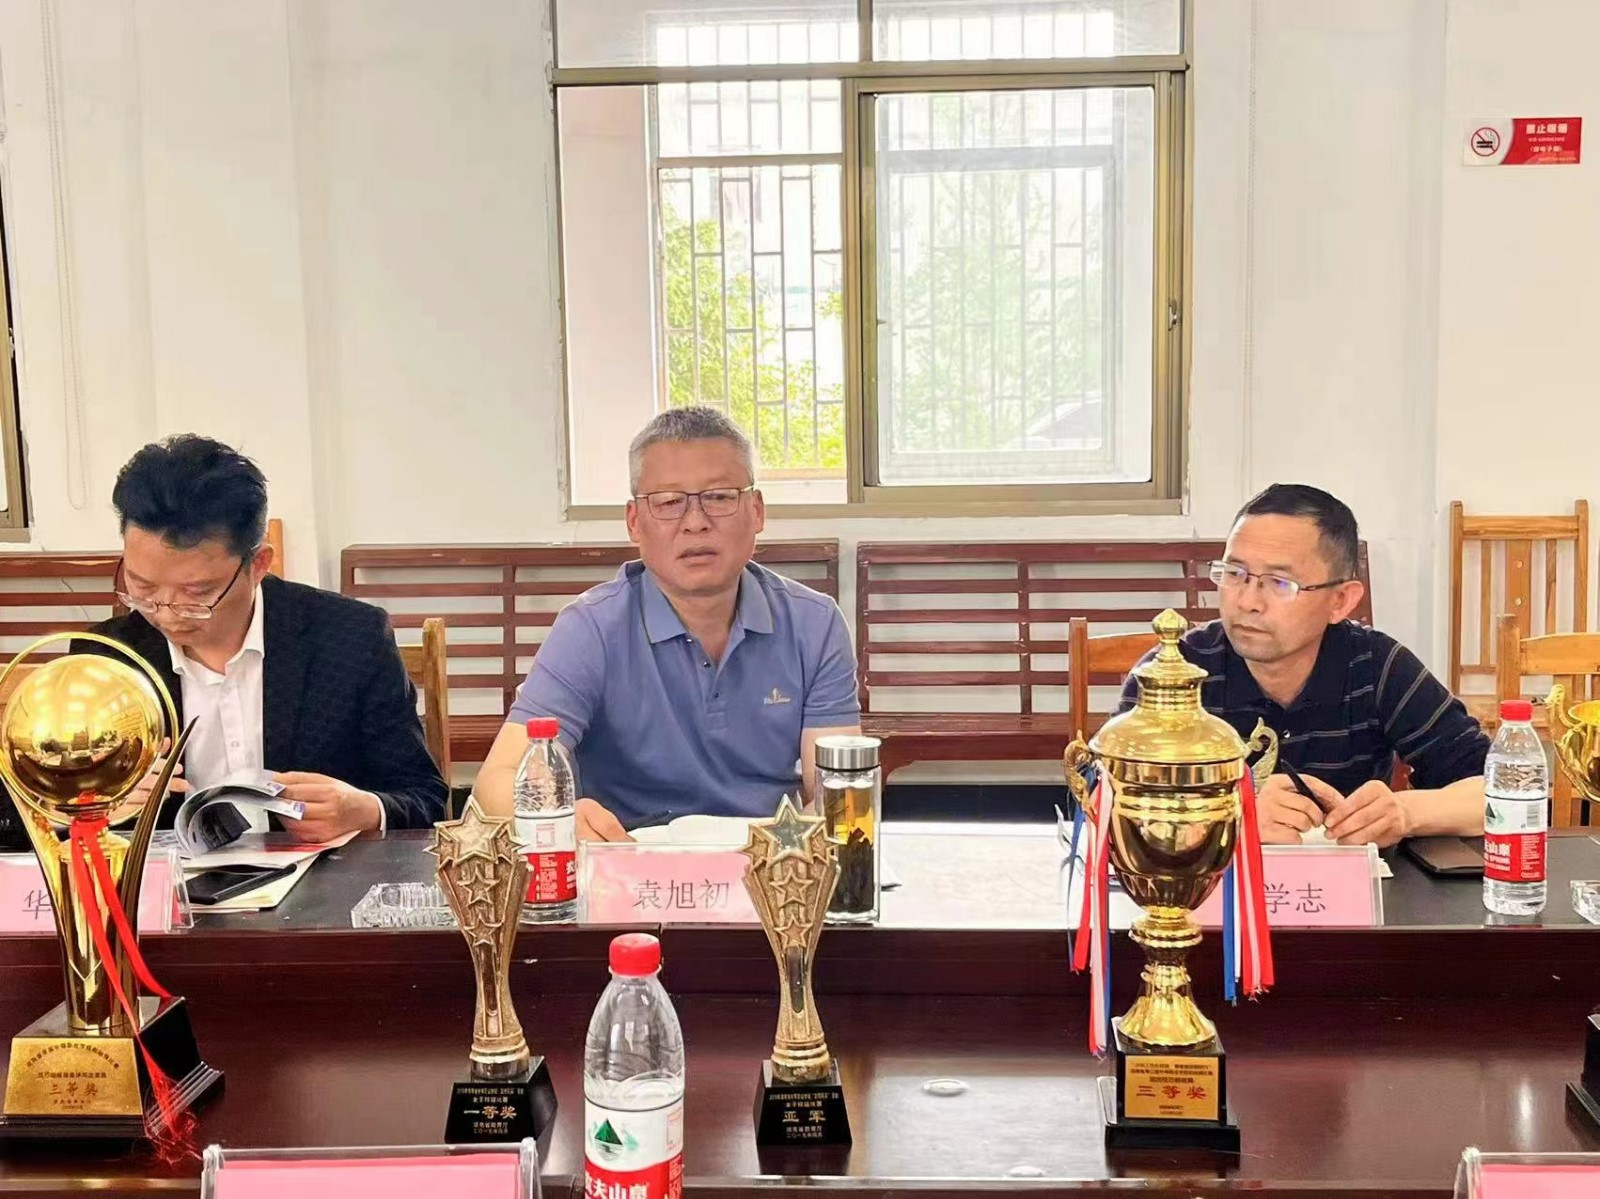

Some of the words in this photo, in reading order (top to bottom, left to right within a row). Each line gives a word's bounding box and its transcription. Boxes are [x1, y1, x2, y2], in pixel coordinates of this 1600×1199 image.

[632, 878, 729, 910] 袁旭初
[1263, 882, 1326, 914] 学志
[22, 890, 52, 920] 华
[49, 1081, 98, 1097] 三等奖
[1136, 1085, 1206, 1100] 三等奖
[463, 1105, 517, 1119] 一等奖
[782, 1110, 826, 1123] 亚军
